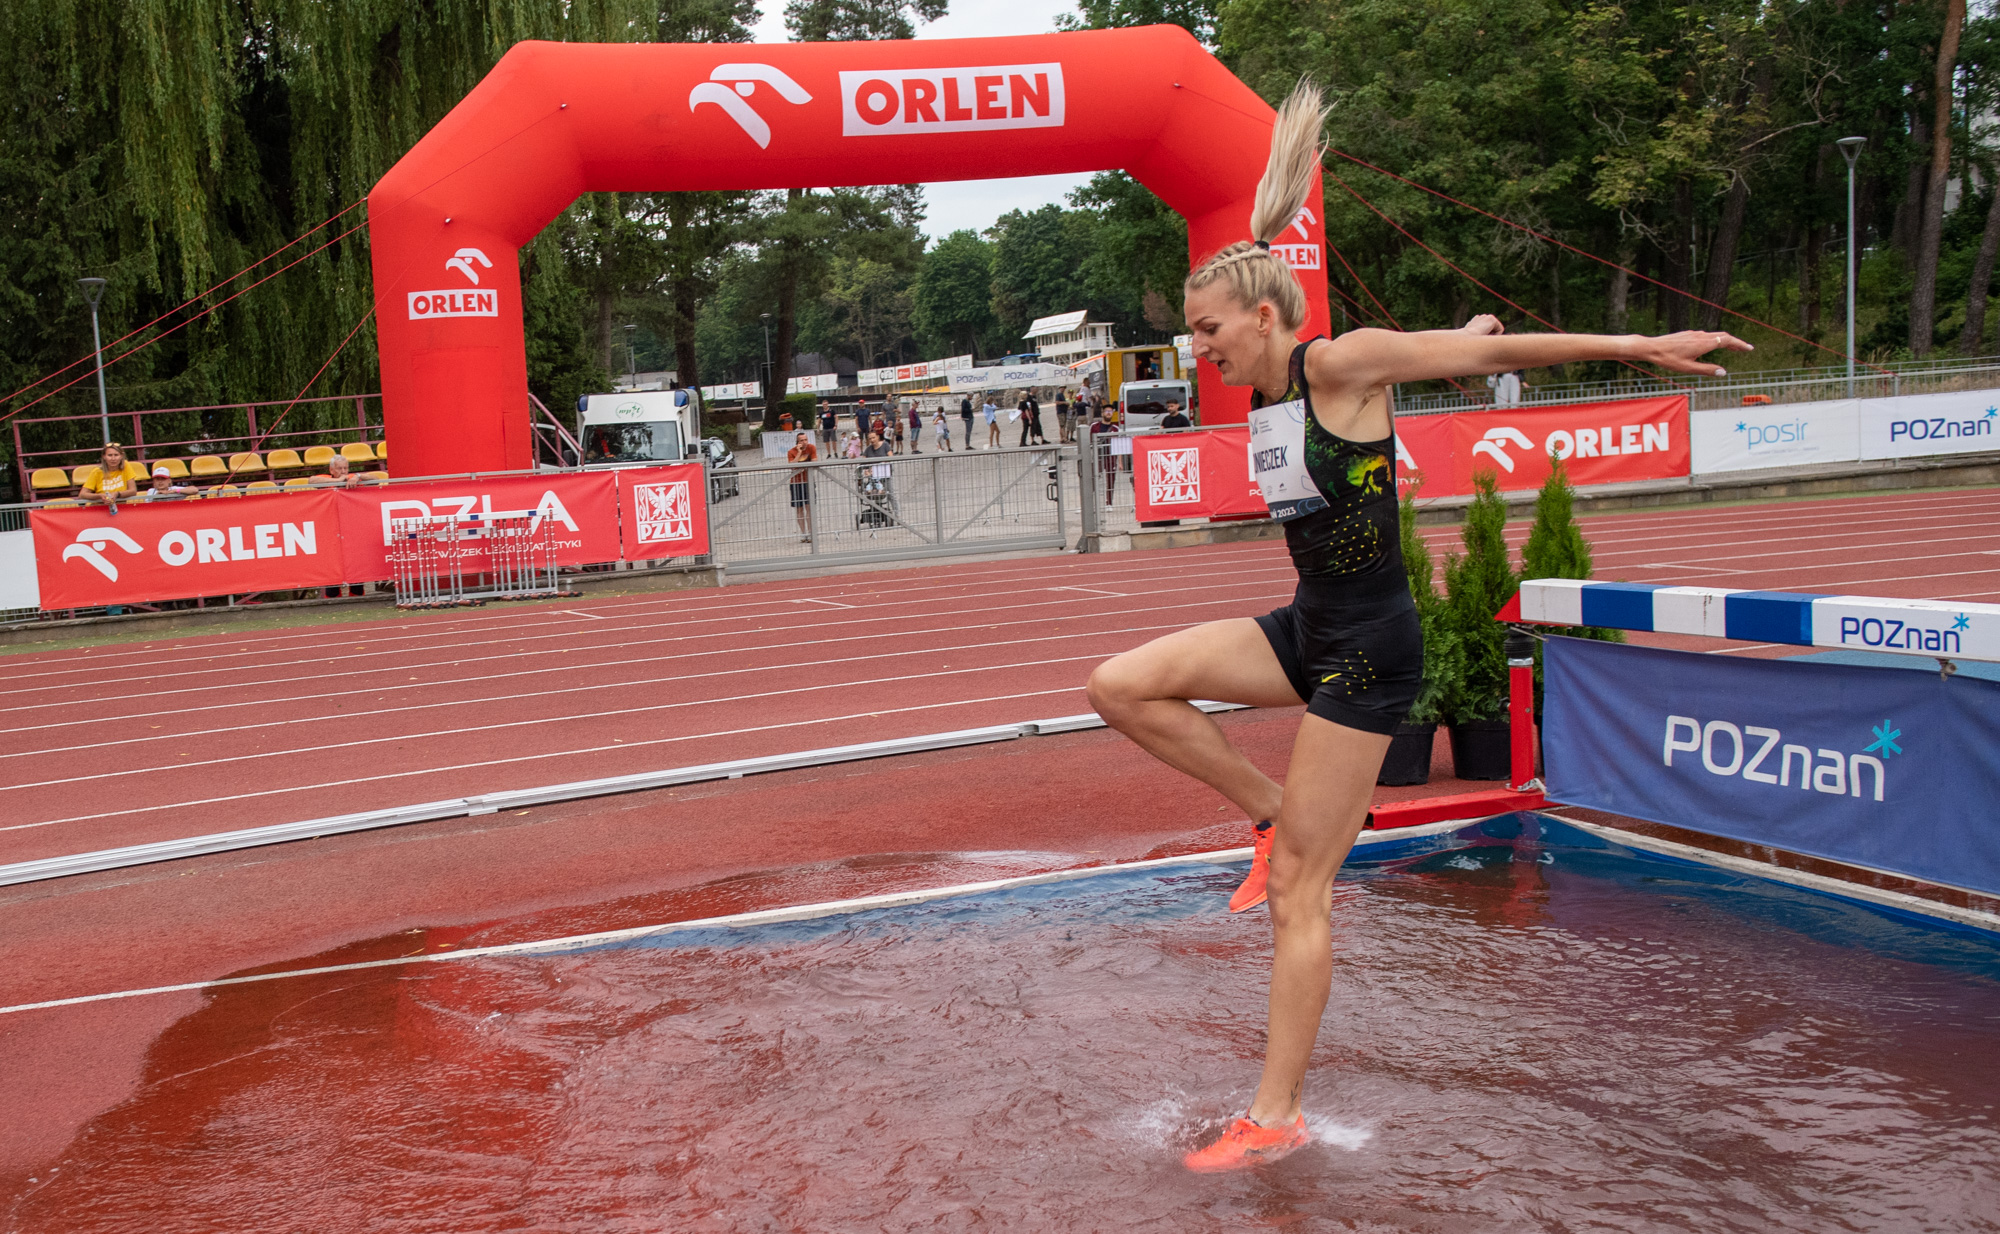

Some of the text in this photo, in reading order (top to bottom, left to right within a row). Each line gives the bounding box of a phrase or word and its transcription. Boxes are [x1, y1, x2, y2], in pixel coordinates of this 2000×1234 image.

[855, 73, 1050, 125] ORLEN
[1270, 248, 1317, 265] RLEN
[413, 294, 493, 315] ORLEN
[1545, 422, 1669, 461] ORLEN
[1152, 485, 1197, 502] PZLA
[1277, 506, 1297, 518] 2023
[640, 521, 689, 540] PZLA
[158, 521, 317, 566] ORLEN
